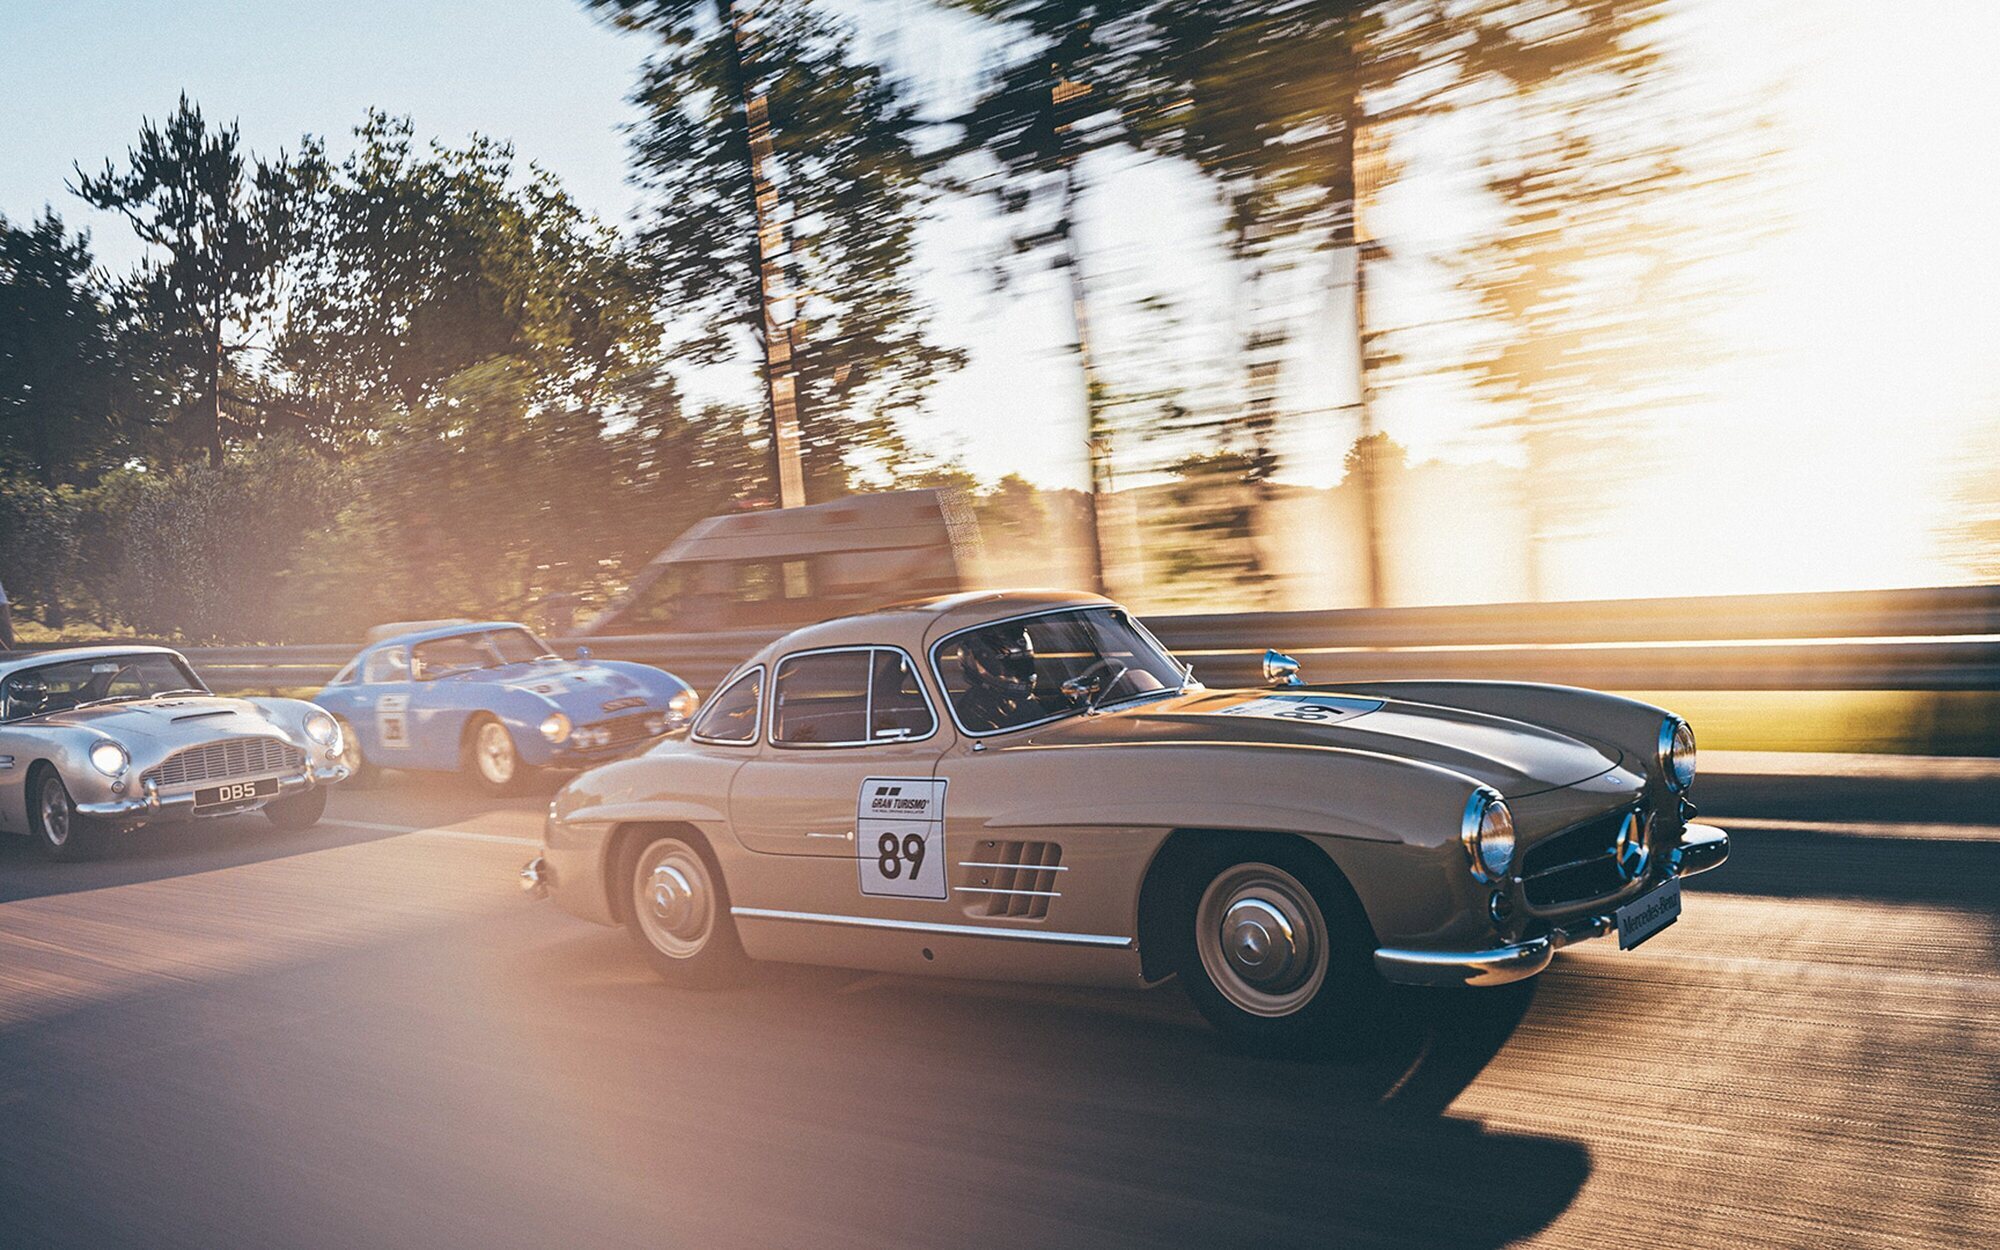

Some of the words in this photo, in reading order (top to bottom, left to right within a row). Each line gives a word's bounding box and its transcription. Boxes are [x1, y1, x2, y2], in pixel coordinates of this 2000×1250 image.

[1273, 705, 1344, 720] 89
[219, 782, 255, 801] DB5
[871, 798, 893, 808] GRAN
[893, 798, 927, 809] TURISMO
[878, 832, 925, 880] 89
[1623, 893, 1679, 937] Mercedes-Benz
